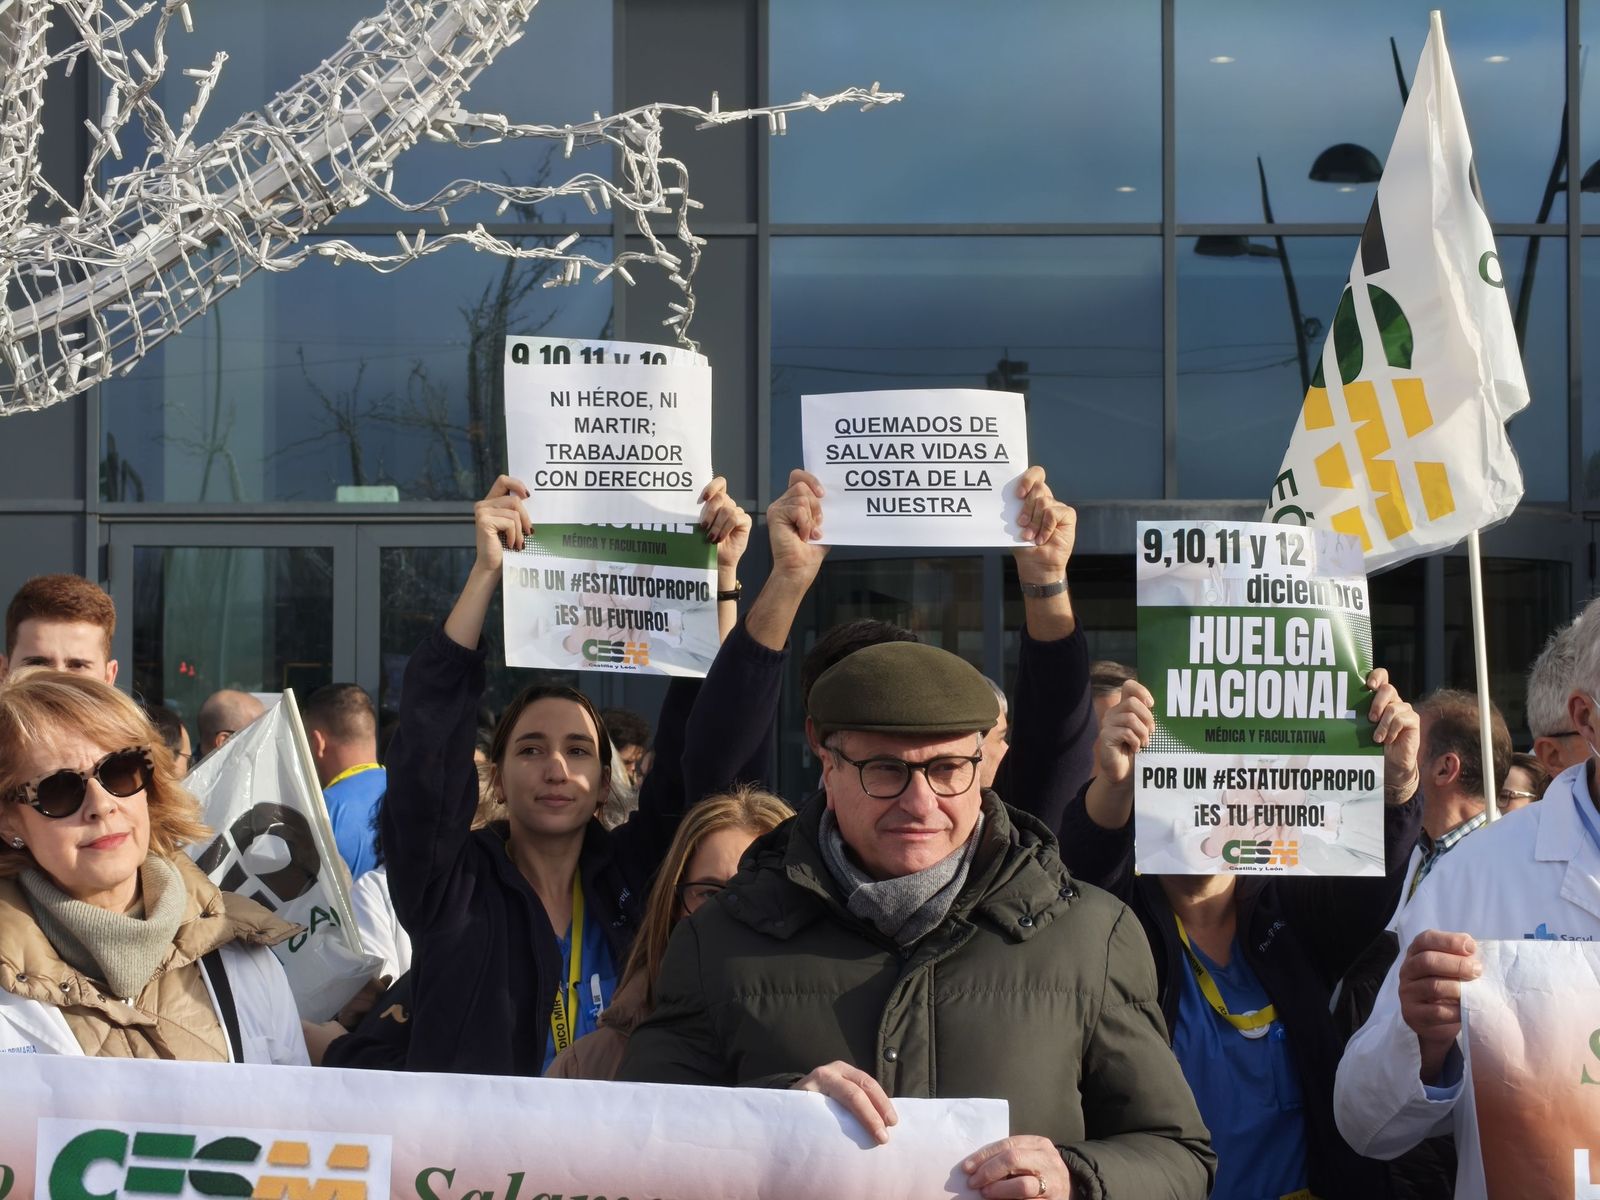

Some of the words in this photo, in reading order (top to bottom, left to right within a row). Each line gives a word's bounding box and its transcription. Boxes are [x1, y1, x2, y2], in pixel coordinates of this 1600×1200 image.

[550, 391, 570, 407] NI
[578, 386, 653, 410] HÉROE,
[660, 392, 678, 409] NI
[574, 417, 656, 436] MARTIR;
[835, 416, 963, 435] QUEMADOS
[970, 416, 999, 433] DE
[546, 443, 682, 462] TRABAJADOR
[826, 443, 915, 461] SALVAR
[921, 443, 987, 460] VIDAS
[994, 443, 1009, 460] A
[535, 470, 578, 488] CON
[585, 470, 693, 488] DERECHOS
[845, 470, 921, 487] COSTA
[927, 470, 957, 487] DE
[964, 470, 993, 487] LA
[866, 497, 972, 514] NUESTRA
[562, 533, 599, 550] MÉDICA
[600, 538, 607, 550] Y
[609, 538, 668, 556] FACULTATIVA
[1143, 528, 1241, 569] 9,10,11
[1250, 533, 1267, 569] y
[1275, 531, 1307, 567] 12
[544, 569, 566, 591] UN
[570, 572, 710, 603] #ESTATUTOPROPIO
[1247, 573, 1364, 611] diciembre
[555, 604, 579, 626] ¡ES
[583, 605, 602, 628] TU
[607, 608, 670, 633] FUTURO!
[582, 638, 650, 666] CESM
[1189, 615, 1336, 666] HUELGA
[1166, 668, 1357, 719] NACIONAL
[1204, 726, 1246, 743] MÉDICA
[1249, 729, 1255, 743] Y
[1258, 728, 1326, 744] FACULTATIVA
[1142, 767, 1178, 790] POR
[1183, 767, 1207, 790] UN
[1213, 768, 1376, 791] #ESTATUTOPROPIO
[1194, 804, 1221, 827] ¡ES
[1226, 804, 1248, 827] TU
[1254, 804, 1326, 827] FUTURO!
[1221, 839, 1299, 866] CESM
